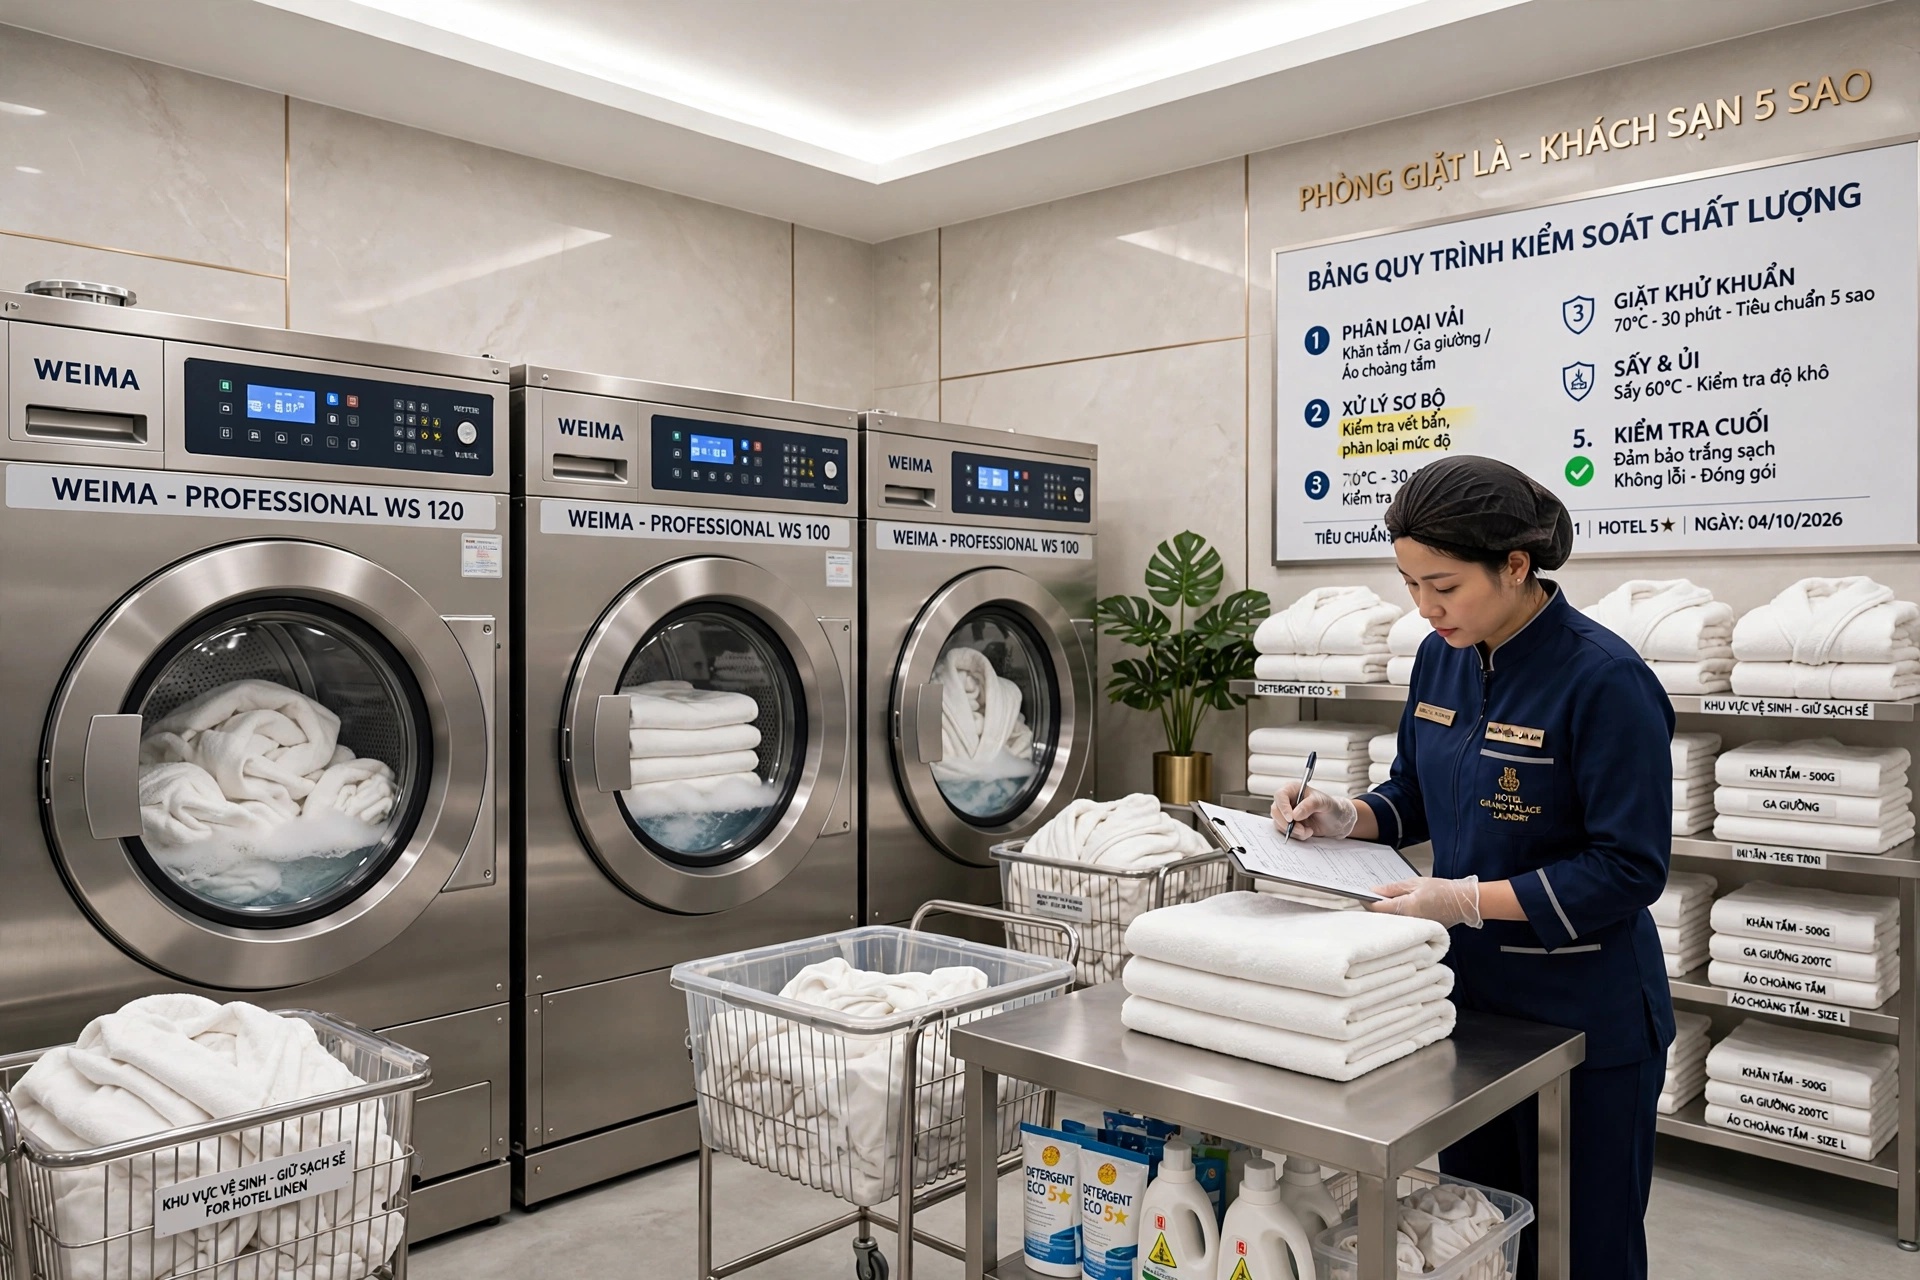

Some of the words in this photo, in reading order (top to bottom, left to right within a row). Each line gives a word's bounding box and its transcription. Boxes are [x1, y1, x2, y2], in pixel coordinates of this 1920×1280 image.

[1299, 170, 1393, 211] PHÒNG
[1400, 151, 1465, 191] GIẶT
[1473, 138, 1511, 177] LÀ
[1540, 113, 1656, 164] KHÁCH
[1667, 94, 1741, 140] SẠN
[1754, 88, 1776, 121] 5
[1788, 68, 1872, 114] SAO
[1308, 261, 1369, 291] BẢNG
[1375, 253, 1424, 282] QUY
[1430, 240, 1503, 271] TRÌNH
[1512, 222, 1574, 259] KIỂM
[1582, 213, 1653, 248] SOÁT
[1661, 194, 1739, 235] CHẤT
[1749, 182, 1861, 222] LƯỢNG
[1614, 285, 1659, 311] GIẶT
[1666, 275, 1712, 303] KHỬ
[1717, 261, 1795, 295] KHUẨN
[1343, 318, 1387, 340] PHÂN
[1393, 313, 1430, 334] LOẠI
[1435, 304, 1464, 328] VẢI
[1573, 304, 1584, 322] 3
[1614, 314, 1648, 333] 70°C
[1661, 310, 1680, 326] 30
[1685, 305, 1722, 328] phút
[1736, 298, 1770, 316] Tiêu
[1775, 288, 1825, 312] chuẩn
[1831, 289, 1840, 305] 5
[1845, 289, 1875, 303] sao
[1312, 331, 1319, 349] 1
[1343, 344, 1373, 360] Khăn
[1377, 339, 1400, 356] tắm
[1404, 339, 1410, 354] /
[1413, 338, 1431, 351] Ga
[1435, 332, 1481, 352] giường
[1342, 362, 1359, 380] Áo
[1362, 362, 1407, 376] choàng
[1411, 355, 1436, 371] tắm
[1614, 352, 1652, 377] SẤY
[1657, 354, 1672, 372] &
[1679, 346, 1699, 370] ỦI
[34, 357, 141, 391] WEIMA
[1614, 381, 1641, 402] Sấy
[1645, 379, 1682, 397] 60°C
[1697, 371, 1737, 392] Kiểm
[1743, 373, 1765, 387] tra
[1770, 368, 1792, 387] độ
[1797, 364, 1829, 382] khô
[1311, 404, 1322, 422] 2
[1342, 394, 1366, 416] XỬ
[1371, 393, 1388, 413] LÝ
[1393, 392, 1417, 411] SƠ
[1421, 387, 1445, 411] BỘ
[558, 417, 624, 442] WEIMA
[1343, 418, 1373, 437] Kiểm
[1377, 421, 1394, 433] tra
[1398, 414, 1418, 431] vết
[1614, 418, 1663, 444] KIỂM
[1668, 420, 1710, 439] TRA
[1715, 408, 1769, 436] CUỐI
[1377, 438, 1398, 455] loại
[1402, 436, 1430, 450] mức
[1434, 434, 1451, 451] độ
[1572, 429, 1593, 449] 5.
[888, 454, 933, 474] WEIMA
[1614, 449, 1649, 466] Đảm
[1654, 447, 1684, 464] bảo
[1689, 442, 1732, 463] trắng
[1737, 440, 1775, 461] sạch
[1311, 476, 1322, 494] 3
[1391, 469, 1408, 483] 30
[1614, 471, 1663, 490] Không
[1668, 466, 1685, 485] lỗi
[1700, 466, 1745, 485] Đóng
[1750, 463, 1776, 484] gói
[52, 476, 158, 506] WEIMA
[185, 484, 378, 518] PROFESSIONAL
[384, 496, 421, 520] WS
[427, 500, 464, 521] 120
[1342, 489, 1372, 506] Kiểm
[1376, 492, 1392, 504] tra
[568, 509, 633, 531] WEIMA
[651, 513, 774, 538] PROFESSIONAL
[778, 522, 802, 540] WS
[806, 524, 831, 541] 100
[1599, 521, 1647, 535] HOTEL
[1695, 515, 1743, 531] NGÀY:
[1748, 512, 1843, 530] 04/10/2026
[893, 529, 939, 547] WEIMA
[950, 533, 1038, 552] PROFESSIONAL
[1041, 538, 1058, 554] WS
[1060, 540, 1079, 554] 100
[1315, 529, 1341, 544] TIÊU
[1258, 684, 1305, 695] DETERGENT
[1308, 685, 1324, 695] ECO
[1704, 701, 1726, 711] KHU
[1728, 701, 1749, 715] VỰC
[1751, 700, 1765, 715] VỆ
[1767, 702, 1792, 713] SINH
[1802, 702, 1822, 714] GIỮ
[1823, 705, 1853, 718] SẠCH
[1749, 766, 1777, 779] KHĂN
[1809, 772, 1835, 782] 500G
[1495, 793, 1523, 803] HOTEL
[1509, 804, 1542, 814] PALACE
[1762, 799, 1777, 809] GA
[1779, 799, 1819, 812] GIƯỜNG
[1493, 811, 1530, 822] LAUNDRY
[1746, 917, 1773, 929] KHĂN
[1805, 925, 1830, 937] 500G
[1743, 947, 1757, 958] GA
[1759, 949, 1799, 963] GIƯỜNG
[1801, 955, 1832, 968] 200TC
[1743, 972, 1758, 985] ÁO
[1760, 976, 1802, 991] CHOÀNG
[1731, 993, 1745, 1005] ÁO
[1747, 998, 1786, 1012] CHOÀNG
[1817, 1009, 1837, 1021] SIZE
[1840, 1013, 1846, 1023] L
[1742, 1067, 1770, 1080] KHĂN
[1802, 1079, 1827, 1092] 500G
[1740, 1094, 1754, 1105] GA
[1756, 1097, 1795, 1113] GIƯỜNG
[1798, 1105, 1828, 1120] 200TC
[1727, 1113, 1741, 1126] ÁO
[1743, 1119, 1785, 1136] CHOÀNG
[1817, 1135, 1838, 1148] SIZE
[1841, 1139, 1847, 1150] L
[162, 1193, 189, 1211] KHU
[192, 1186, 218, 1205] VỰC
[220, 1178, 237, 1197] VỆ
[238, 1174, 267, 1192] SINH
[277, 1163, 299, 1182] GIỮ
[300, 1157, 330, 1176] SẠCH
[1026, 1165, 1074, 1186] DETERGENT
[206, 1200, 230, 1217] FOR
[232, 1190, 272, 1210] HOTEL
[274, 1179, 308, 1200] LINEN
[1027, 1180, 1046, 1195] ECO
[1083, 1183, 1132, 1206] DETERGENT
[1084, 1198, 1102, 1215] ECO
